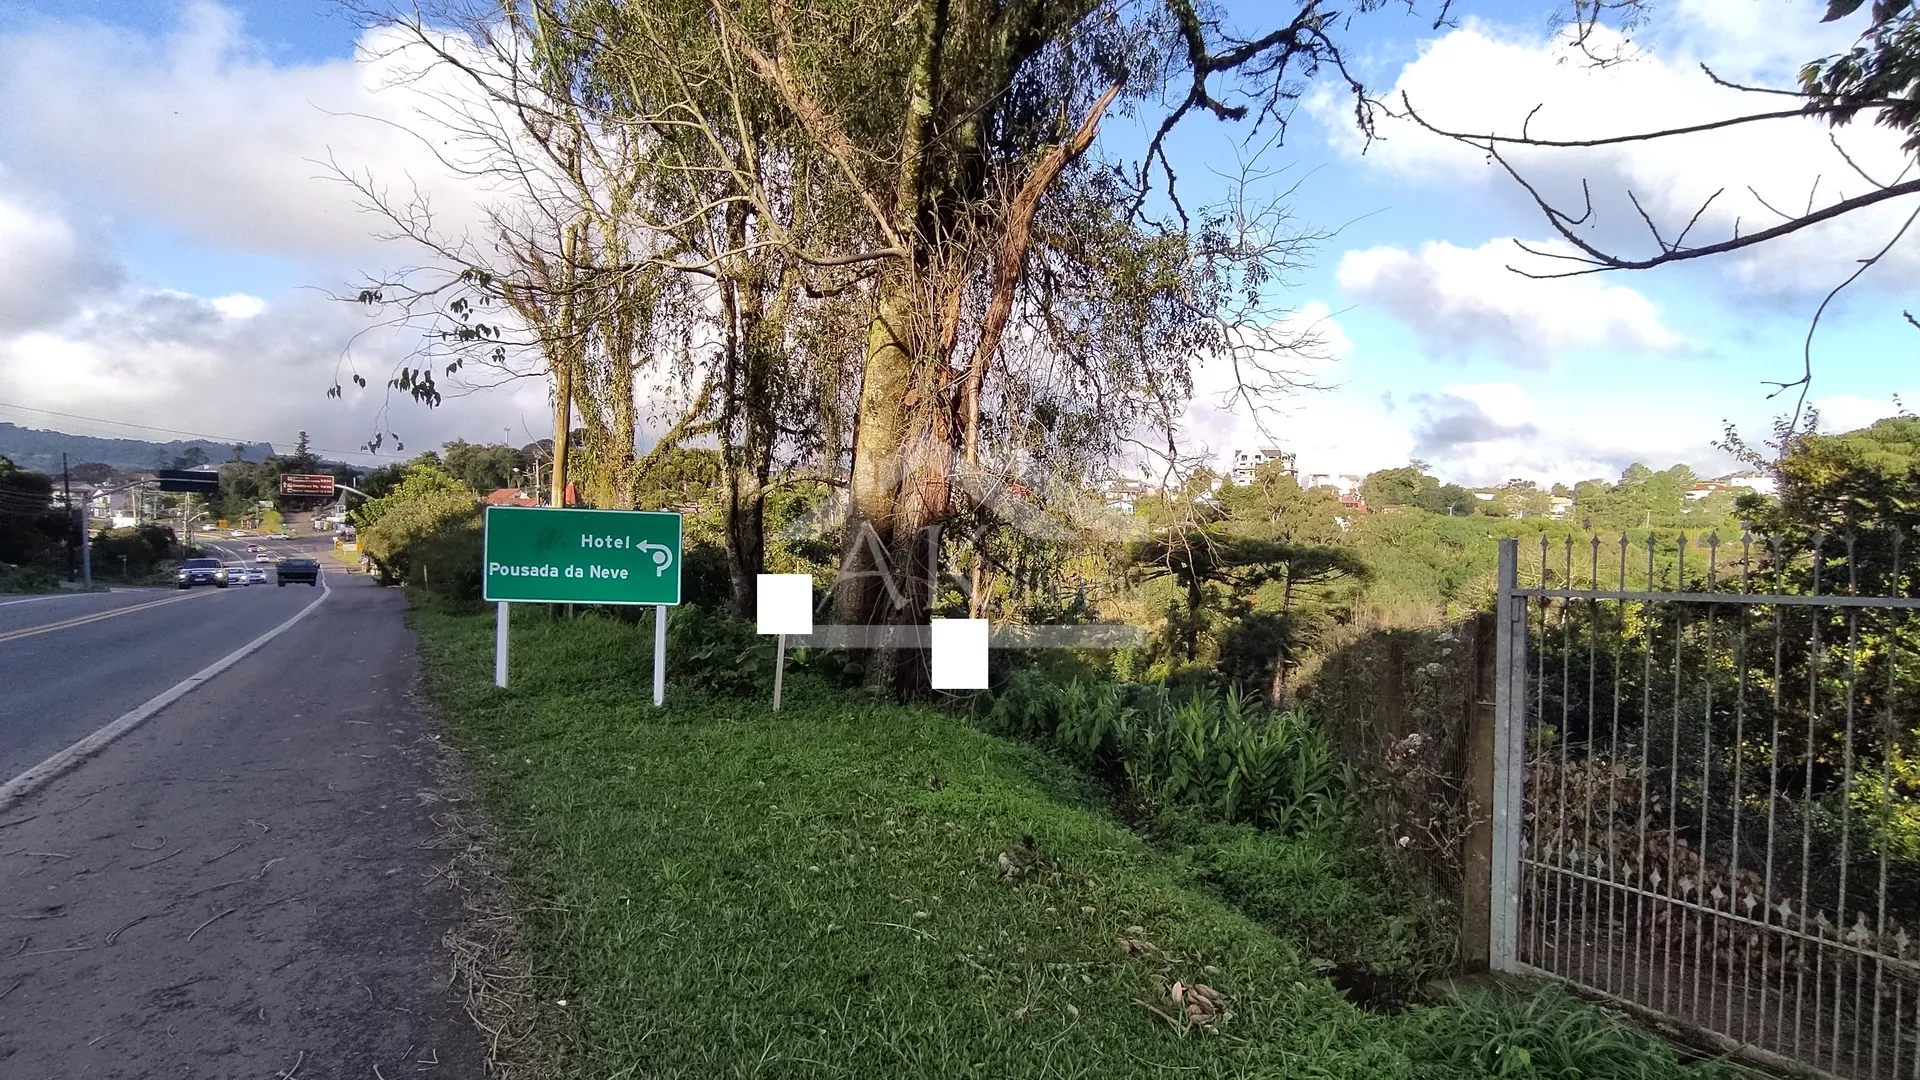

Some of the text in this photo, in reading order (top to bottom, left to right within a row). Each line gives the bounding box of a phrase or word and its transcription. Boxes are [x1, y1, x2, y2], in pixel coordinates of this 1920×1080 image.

[581, 534, 630, 549] Hotel
[489, 562, 629, 579] Pousada da Neve
